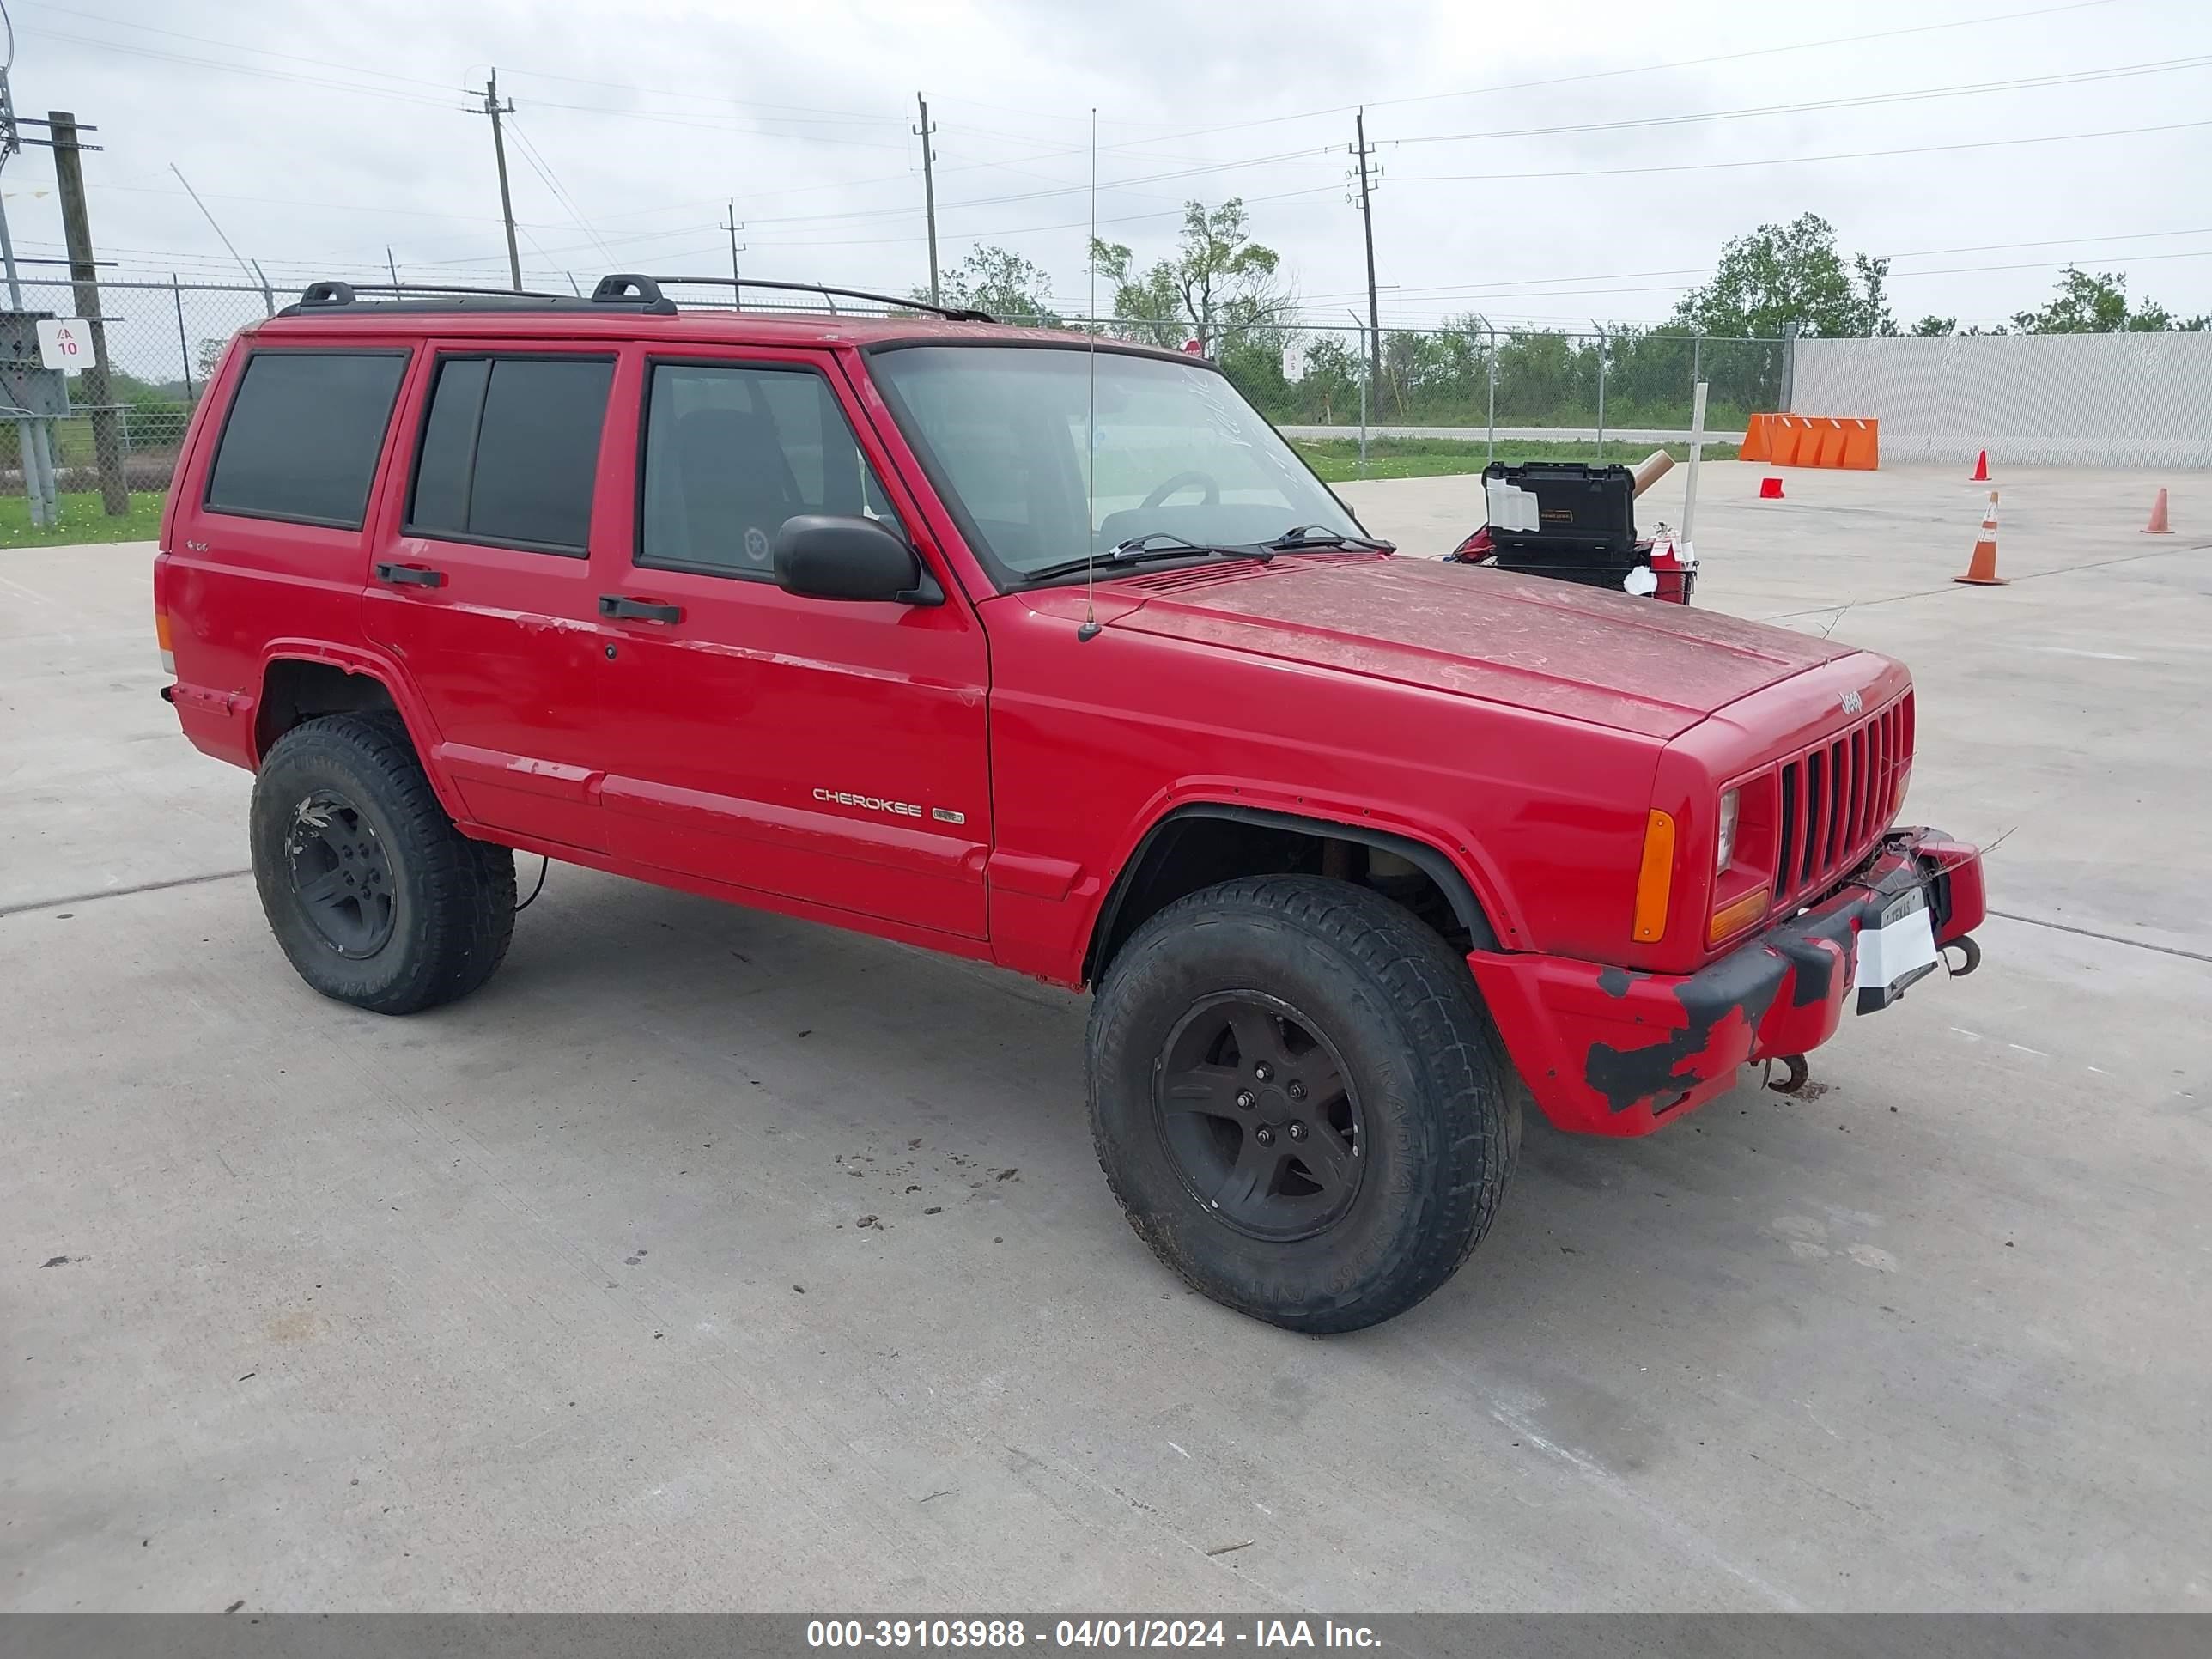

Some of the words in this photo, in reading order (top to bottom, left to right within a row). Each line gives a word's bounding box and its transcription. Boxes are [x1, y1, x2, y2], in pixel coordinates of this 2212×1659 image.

[58, 342, 78, 356] 10
[812, 787, 922, 817] CHEROKEE
[1892, 900, 1911, 921] TEXAS
